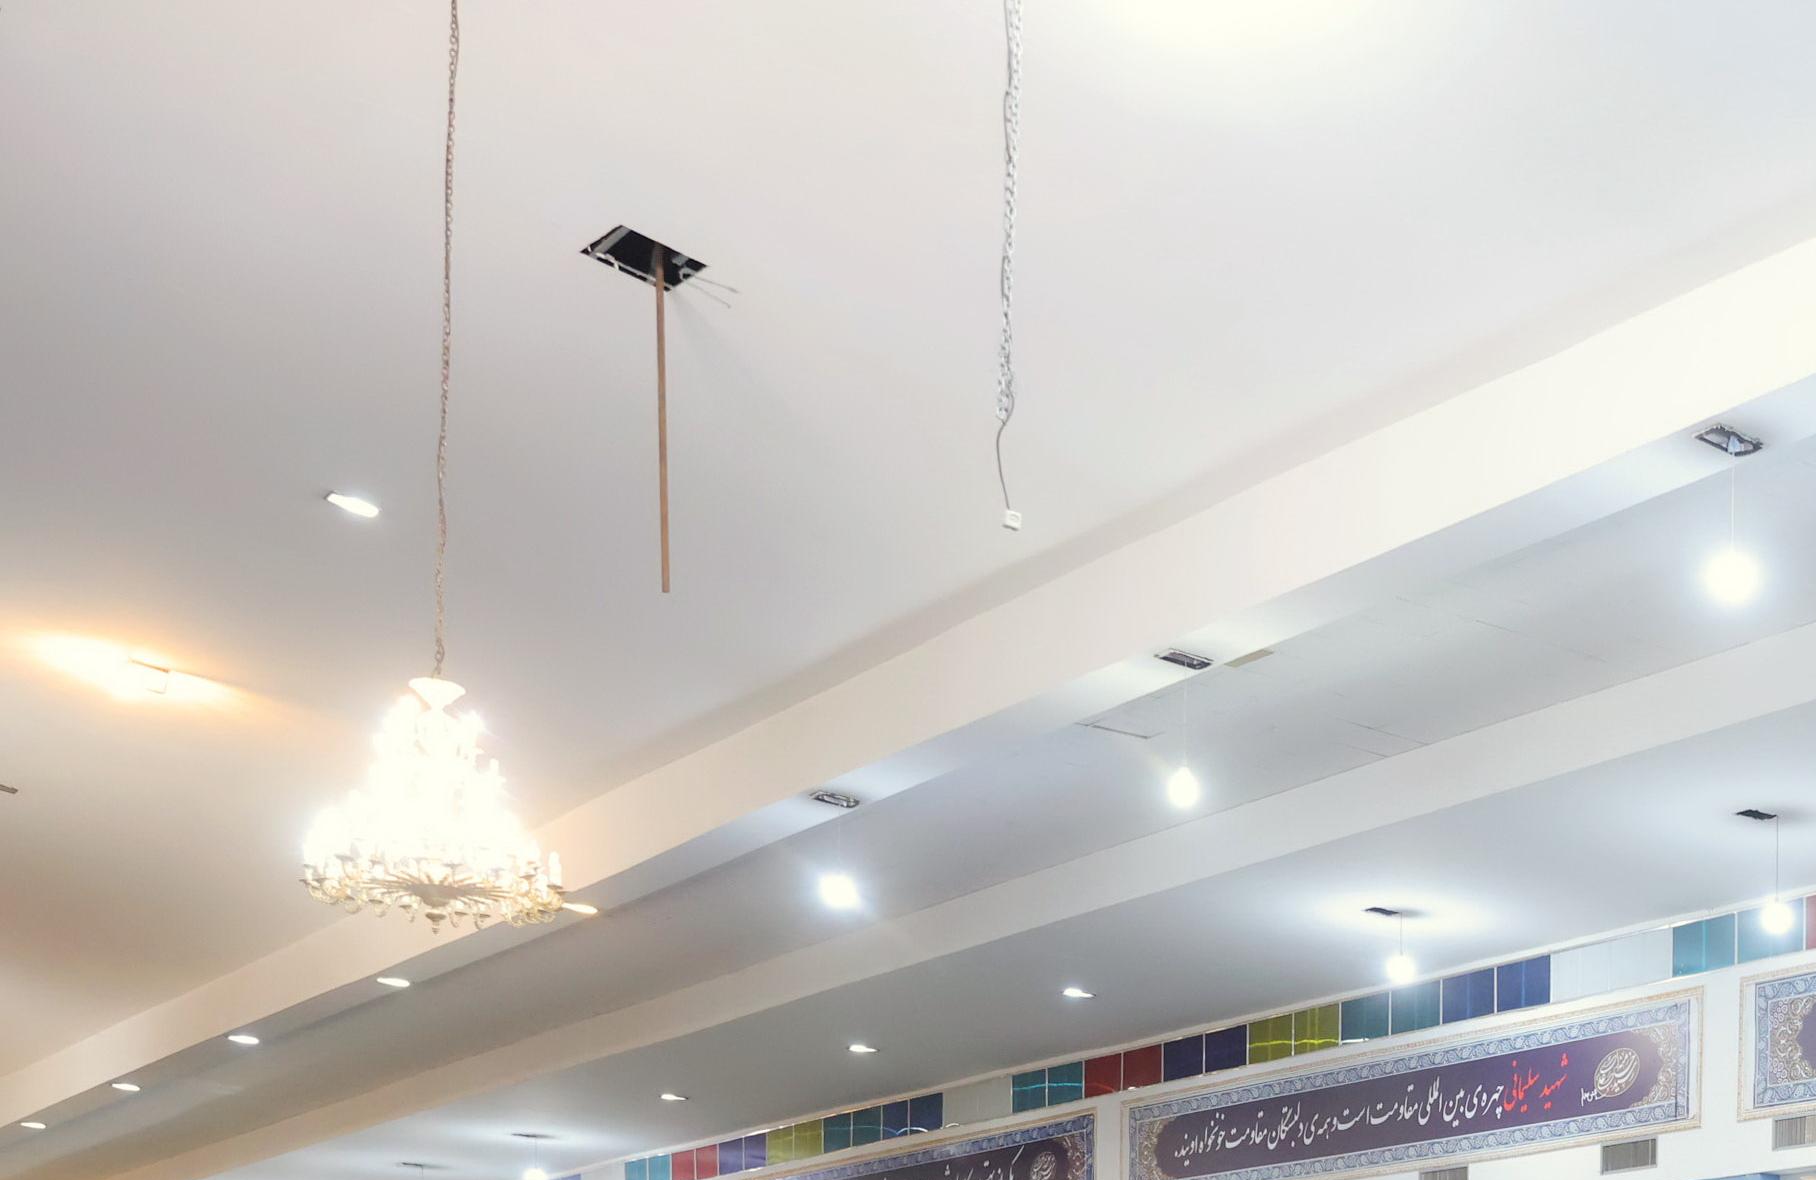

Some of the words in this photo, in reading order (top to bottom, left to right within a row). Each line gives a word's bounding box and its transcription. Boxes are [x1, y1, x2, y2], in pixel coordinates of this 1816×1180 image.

[1503, 1060, 1540, 1112] سلیمانی
[1539, 1052, 1569, 1110] شهید
[1337, 1105, 1369, 1131] است
[1370, 1083, 1418, 1125] مقاومت
[1225, 1110, 1267, 1149] مقاومت
